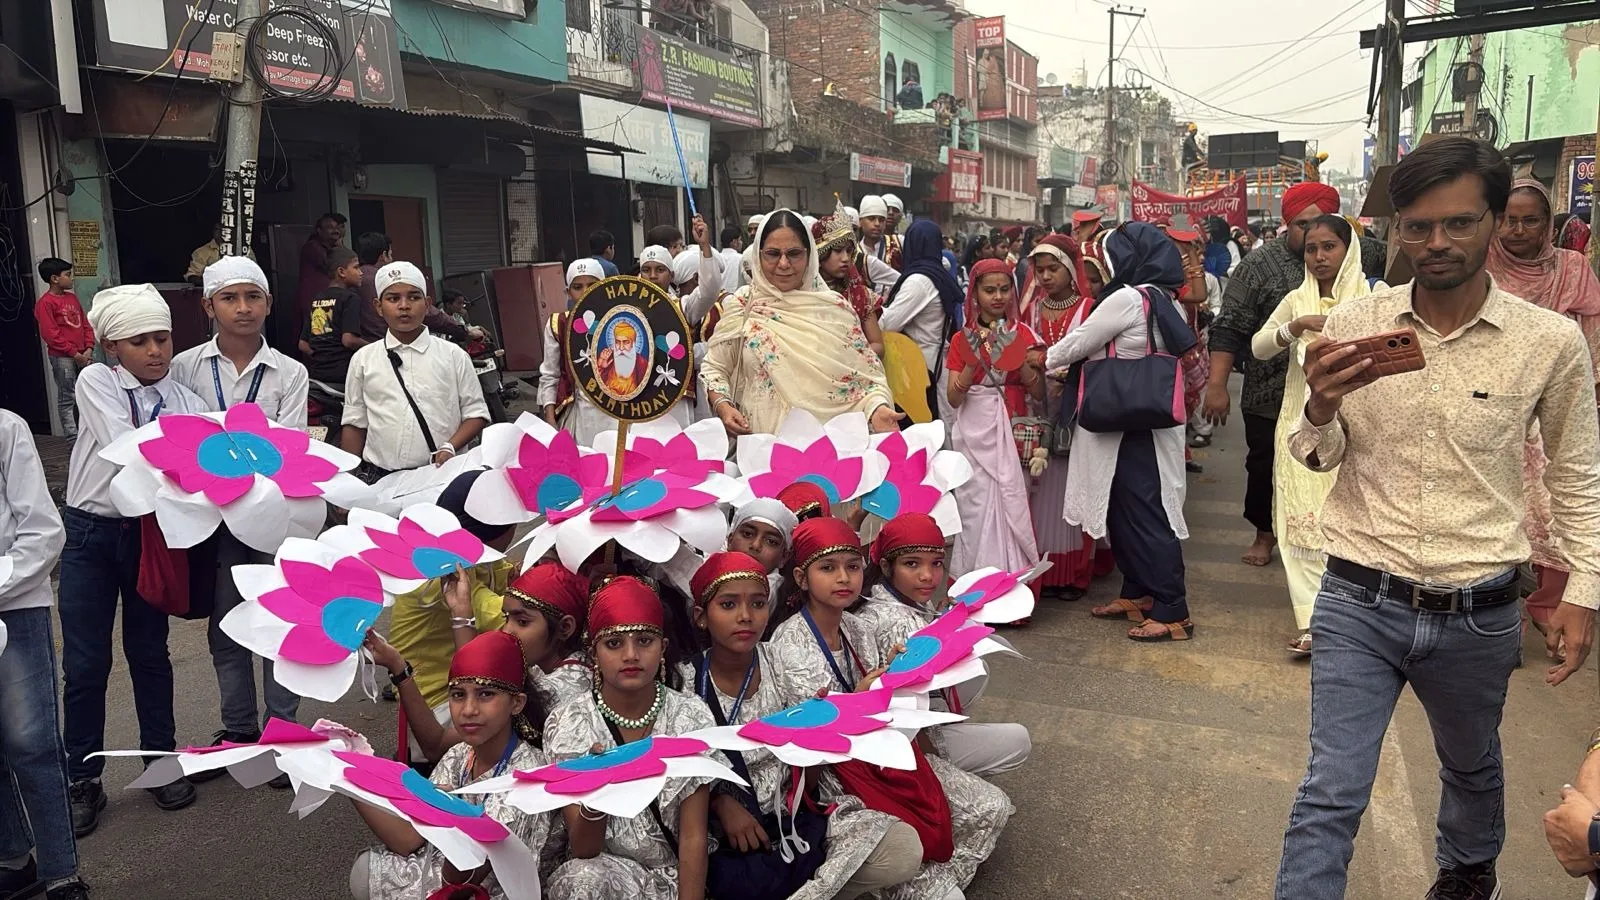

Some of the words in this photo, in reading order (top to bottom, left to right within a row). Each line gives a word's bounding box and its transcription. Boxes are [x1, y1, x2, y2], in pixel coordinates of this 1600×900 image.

[185, 4, 221, 25] Water
[267, 22, 294, 44] Deep
[977, 26, 1001, 38] TOP
[291, 53, 311, 68] etc.
[661, 43, 681, 66] Z.R.
[681, 49, 718, 77] FASHION
[717, 60, 755, 89] BOUTIQUE
[604, 282, 661, 309] HAPPY
[585, 376, 670, 418] BIRTHDAY
